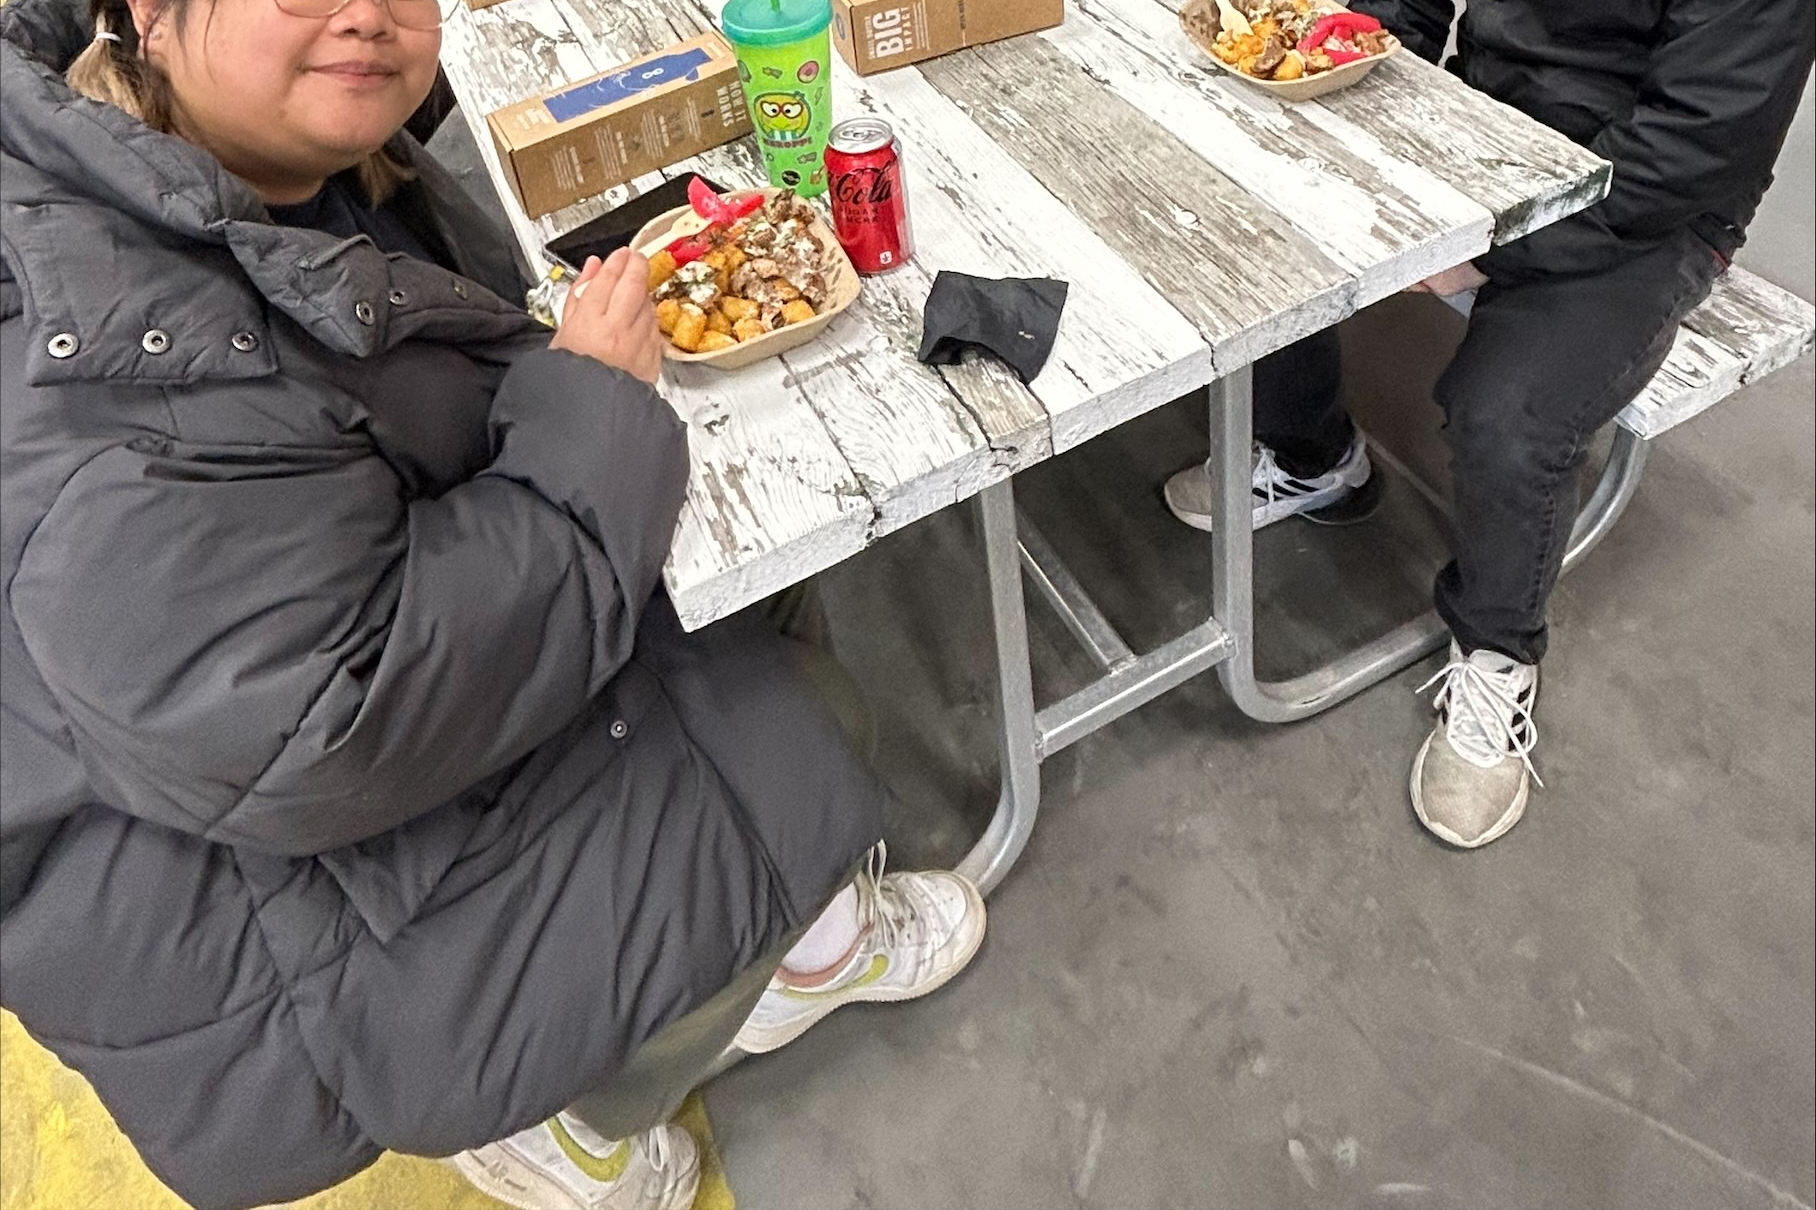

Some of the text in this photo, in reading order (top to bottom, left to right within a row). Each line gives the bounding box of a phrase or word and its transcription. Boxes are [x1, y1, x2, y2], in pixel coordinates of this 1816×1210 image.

[872, 7, 905, 59] BIG
[900, 6, 914, 52] IMPACT
[716, 87, 735, 128] WORKS
[729, 80, 747, 123] HOW IT
